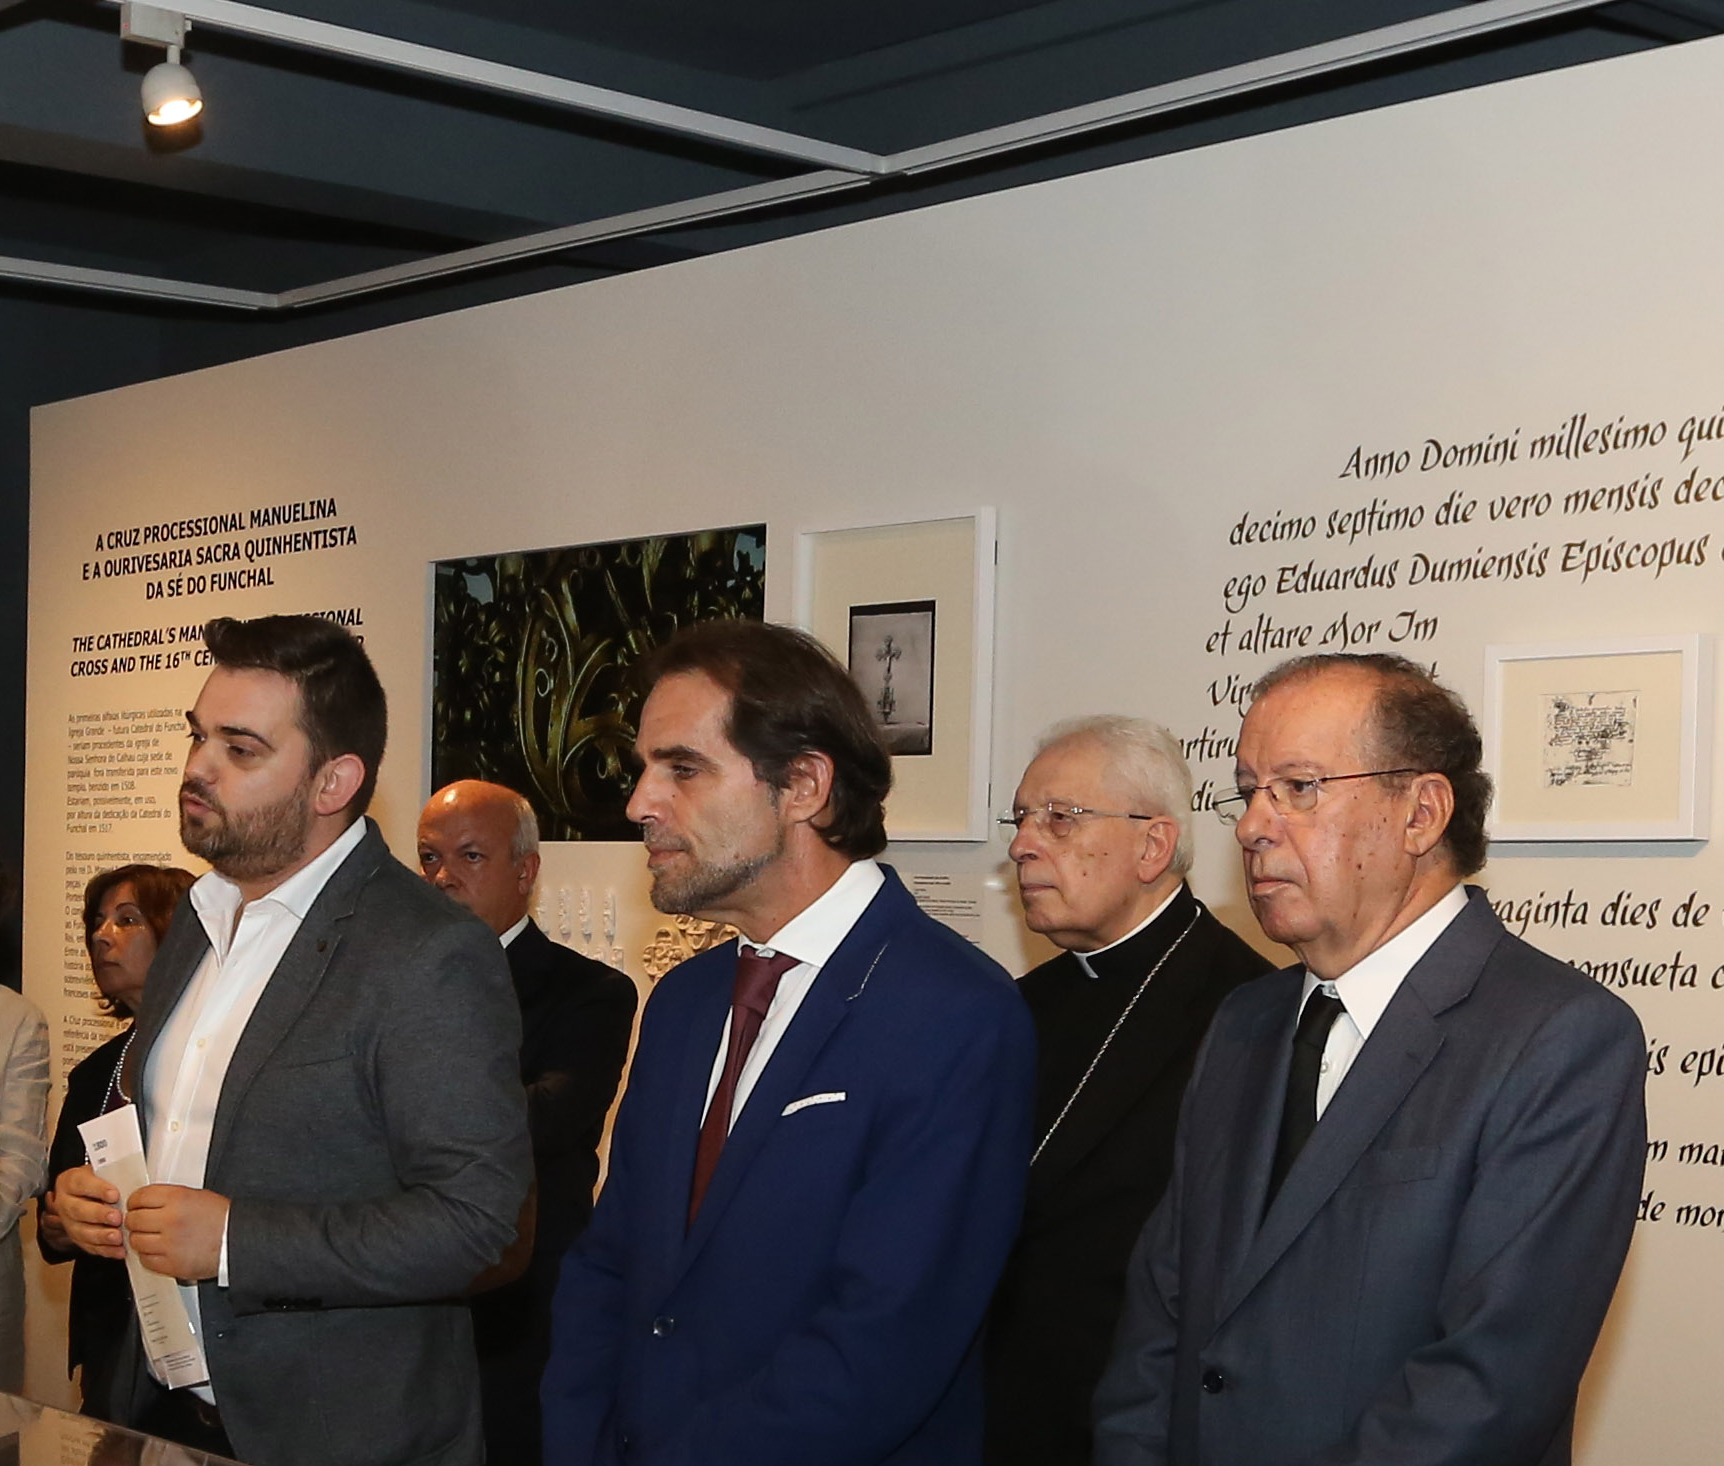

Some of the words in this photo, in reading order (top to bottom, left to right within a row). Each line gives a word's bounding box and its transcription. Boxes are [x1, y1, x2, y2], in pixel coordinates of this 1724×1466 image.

[1338, 445, 1411, 481] Anno
[1420, 427, 1521, 472] Domini
[1529, 412, 1666, 460] millesimo
[95, 534, 104, 551] A
[106, 528, 140, 550] CRUZ
[143, 512, 246, 545] PROCESSIONAL
[250, 498, 337, 529] MANUELINA
[1229, 510, 1316, 546] decimo
[1326, 497, 1425, 546] septimo
[1435, 490, 1478, 527] die
[1488, 486, 1551, 522] vero
[1562, 473, 1664, 515] mensis
[83, 563, 90, 581] E
[93, 562, 101, 579] A
[104, 549, 193, 578] OURIVESARIA
[195, 541, 241, 566] SACRA
[244, 525, 357, 563] QUINHENTISTA
[1223, 574, 1266, 613] ego
[1276, 553, 1400, 595] Eduardus
[1408, 542, 1549, 587] Dumiensis
[1560, 532, 1711, 584] Episcopus
[146, 582, 164, 600] DA
[167, 573, 183, 597] SÉ
[187, 577, 206, 594] DO
[210, 567, 274, 592] FUNCHAL
[73, 636, 94, 653] THE
[1205, 618, 1232, 656] et
[1237, 612, 1313, 654] altare
[71, 655, 108, 677] CROSS
[110, 657, 136, 674] AND
[139, 654, 161, 671] THE
[1601, 890, 1662, 930] dies
[1671, 890, 1710, 928] de
